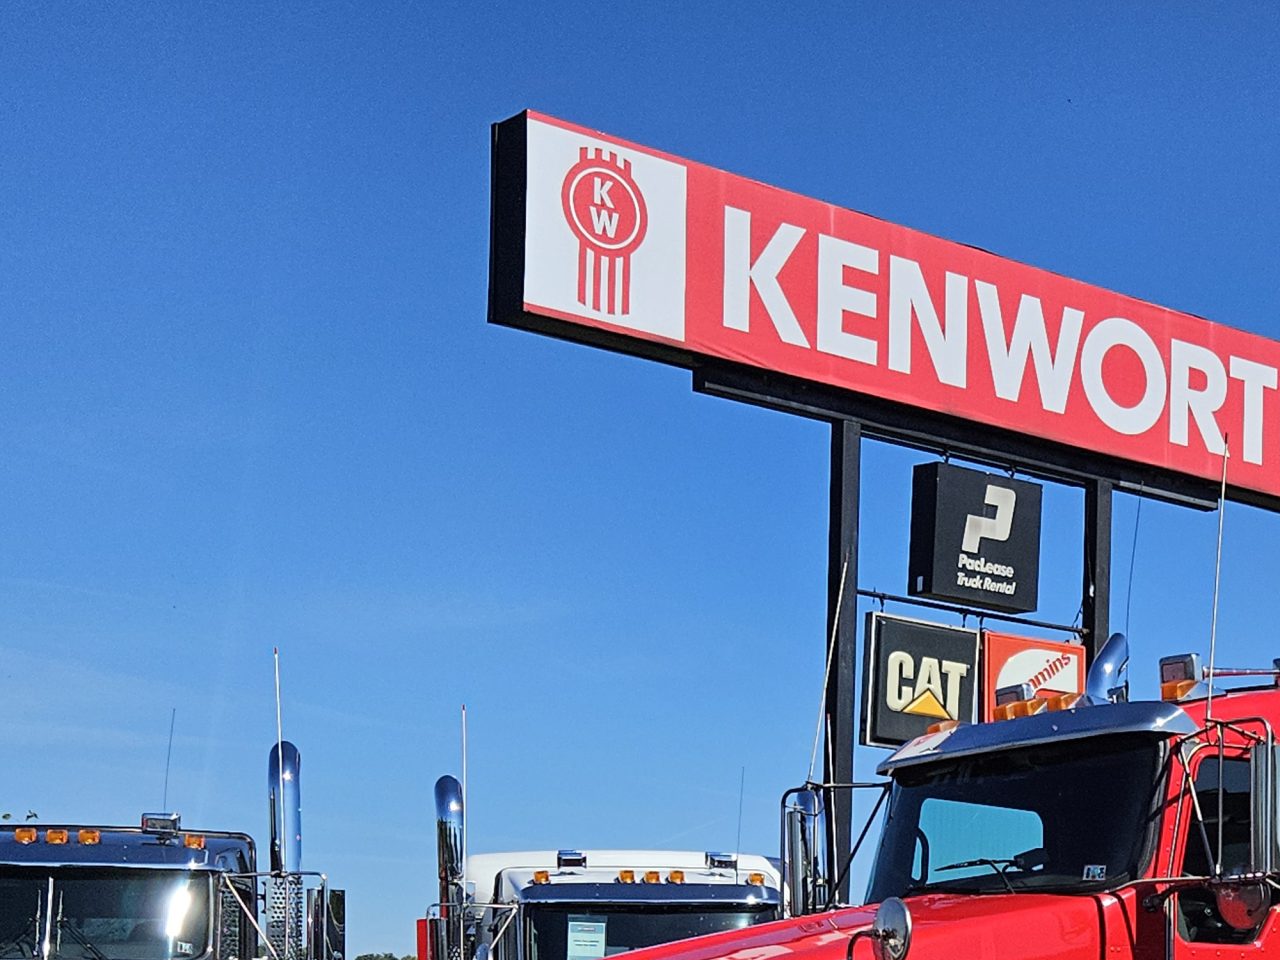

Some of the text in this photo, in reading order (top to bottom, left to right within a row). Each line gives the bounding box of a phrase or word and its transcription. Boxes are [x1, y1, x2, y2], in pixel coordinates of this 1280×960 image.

[593, 176, 615, 209] K
[589, 205, 620, 239] W
[958, 553, 1015, 578] PacLease
[957, 572, 1017, 595] Truck Rental
[886, 650, 968, 721] CAT
